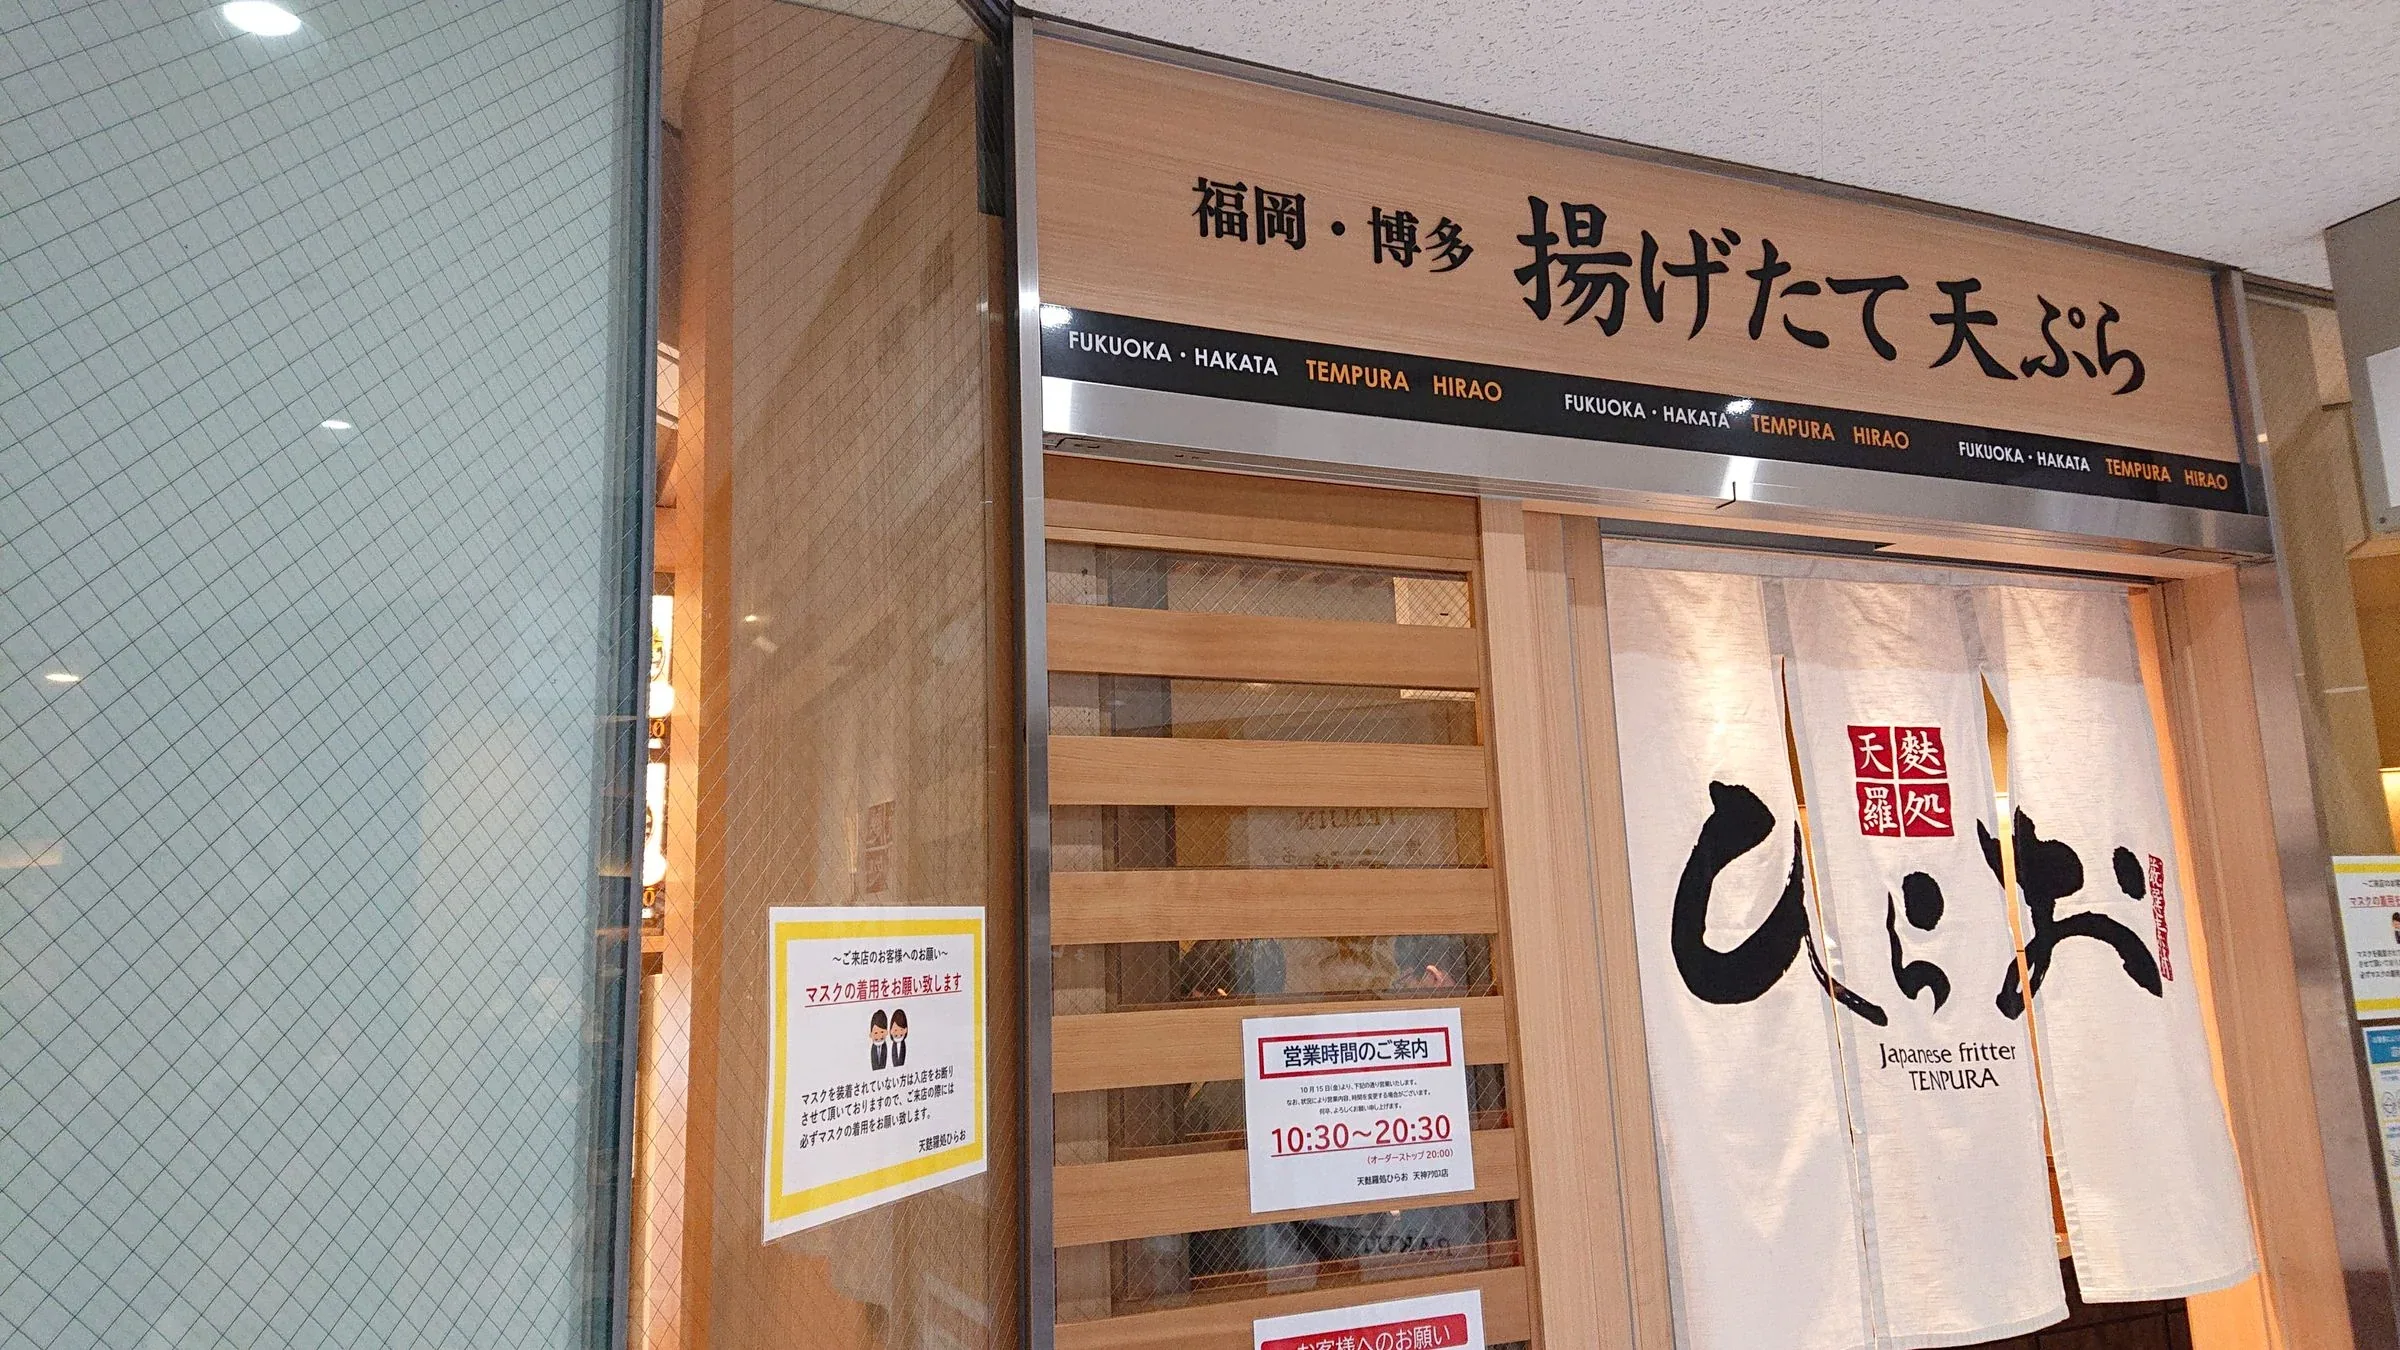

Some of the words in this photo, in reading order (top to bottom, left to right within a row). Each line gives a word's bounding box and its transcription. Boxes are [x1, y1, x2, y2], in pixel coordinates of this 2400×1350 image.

[1514, 195, 2146, 395] 揚げたて天ぷら
[1195, 347, 1278, 376] HAKATA
[1306, 359, 1409, 392] TEMPURA
[1433, 375, 1503, 403] HIRAO
[1663, 406, 1730, 429] HAKATA
[1751, 413, 1836, 441] TEMPURA
[1854, 426, 1910, 450] HIRAO
[2037, 451, 2090, 472] HAKATA
[2105, 457, 2172, 483] TEMPURA
[2184, 469, 2228, 491] HIRAO
[1671, 780, 2163, 1026] ひらお
[805, 972, 962, 1003] マスクの着用をお願い致します
[1283, 1037, 1428, 1068] 営業時間のご案内
[1880, 1043, 1952, 1069] Japanese
[1959, 1042, 2015, 1063] fritter
[801, 1065, 954, 1105] マスクを装着されていない方は入店をお断り
[1909, 1068, 1999, 1091] TENPURA
[801, 1082, 955, 1127] させて頂いておりますので、ご来店の際には
[799, 1107, 931, 1149] 必ずマスクの着用をお願い致します。
